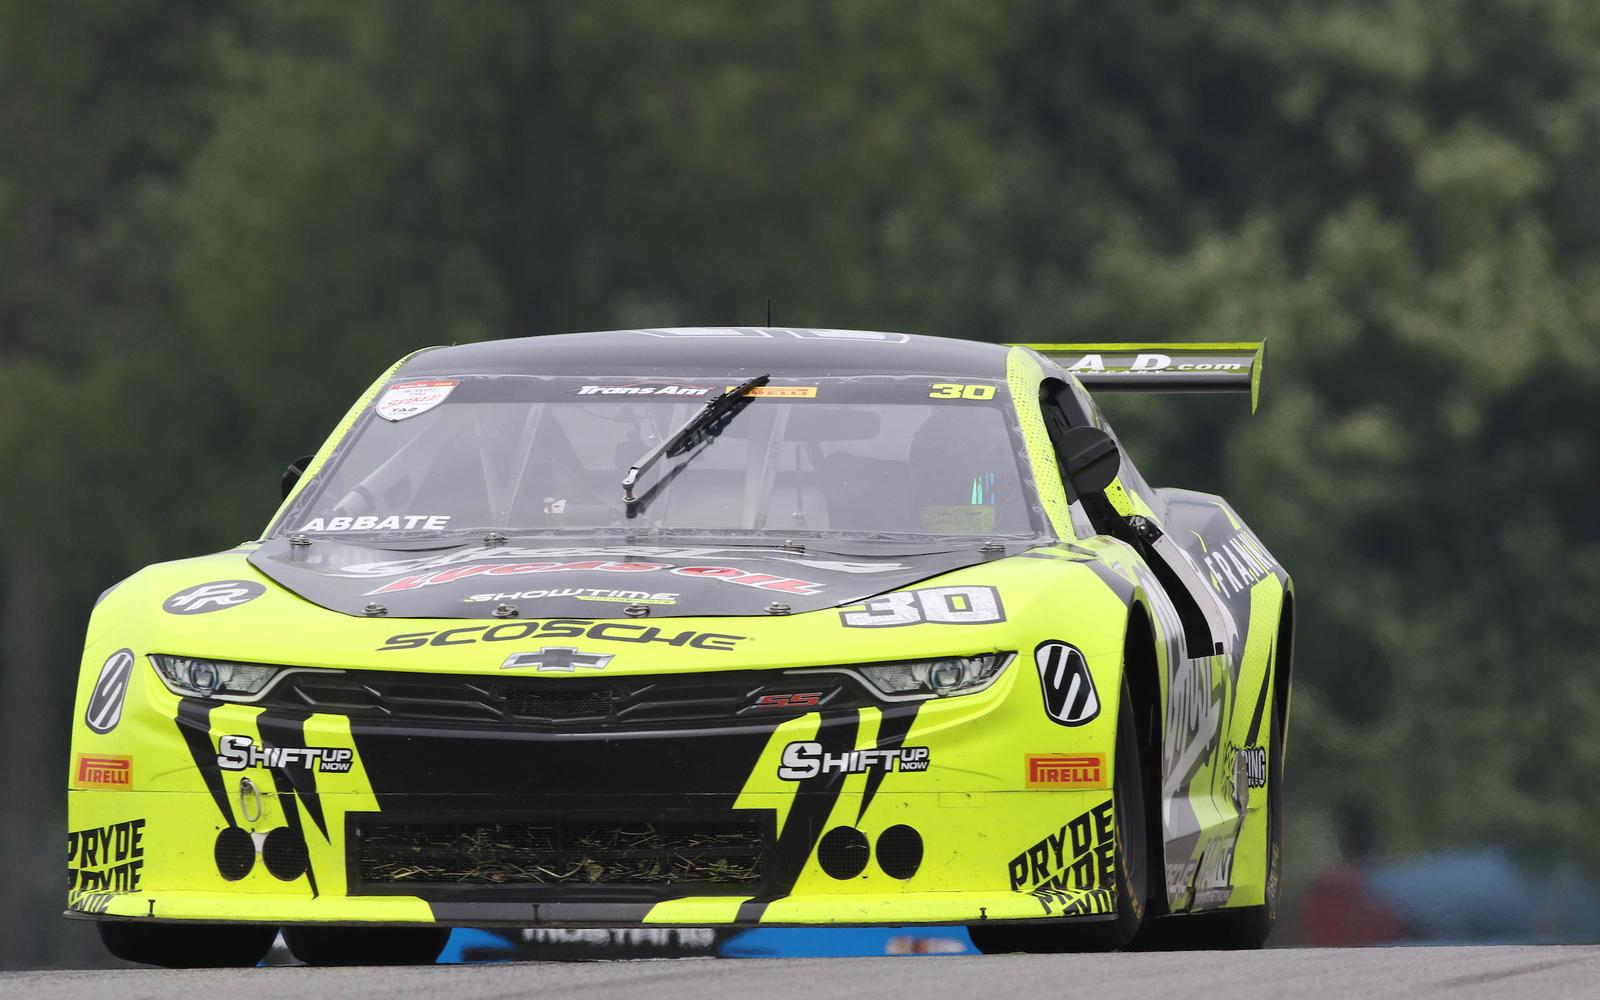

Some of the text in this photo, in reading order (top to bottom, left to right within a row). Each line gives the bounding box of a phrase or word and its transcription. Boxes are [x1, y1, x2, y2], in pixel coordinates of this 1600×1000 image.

[929, 383, 997, 400] 30
[300, 515, 450, 531] ABBATE
[361, 561, 826, 596] LUCAS OIL
[469, 588, 680, 602] SHOWTIME
[838, 586, 1007, 628] 30
[375, 619, 747, 651] SCOSCHE
[755, 692, 823, 708] SS
[321, 748, 351, 762] UP
[901, 747, 929, 760] UP
[79, 757, 129, 785] PIRELLI
[321, 762, 350, 771] NOW
[901, 761, 929, 771] NOW
[1029, 757, 1100, 783] PIRELLI
[1008, 798, 1113, 892] PRYDE
